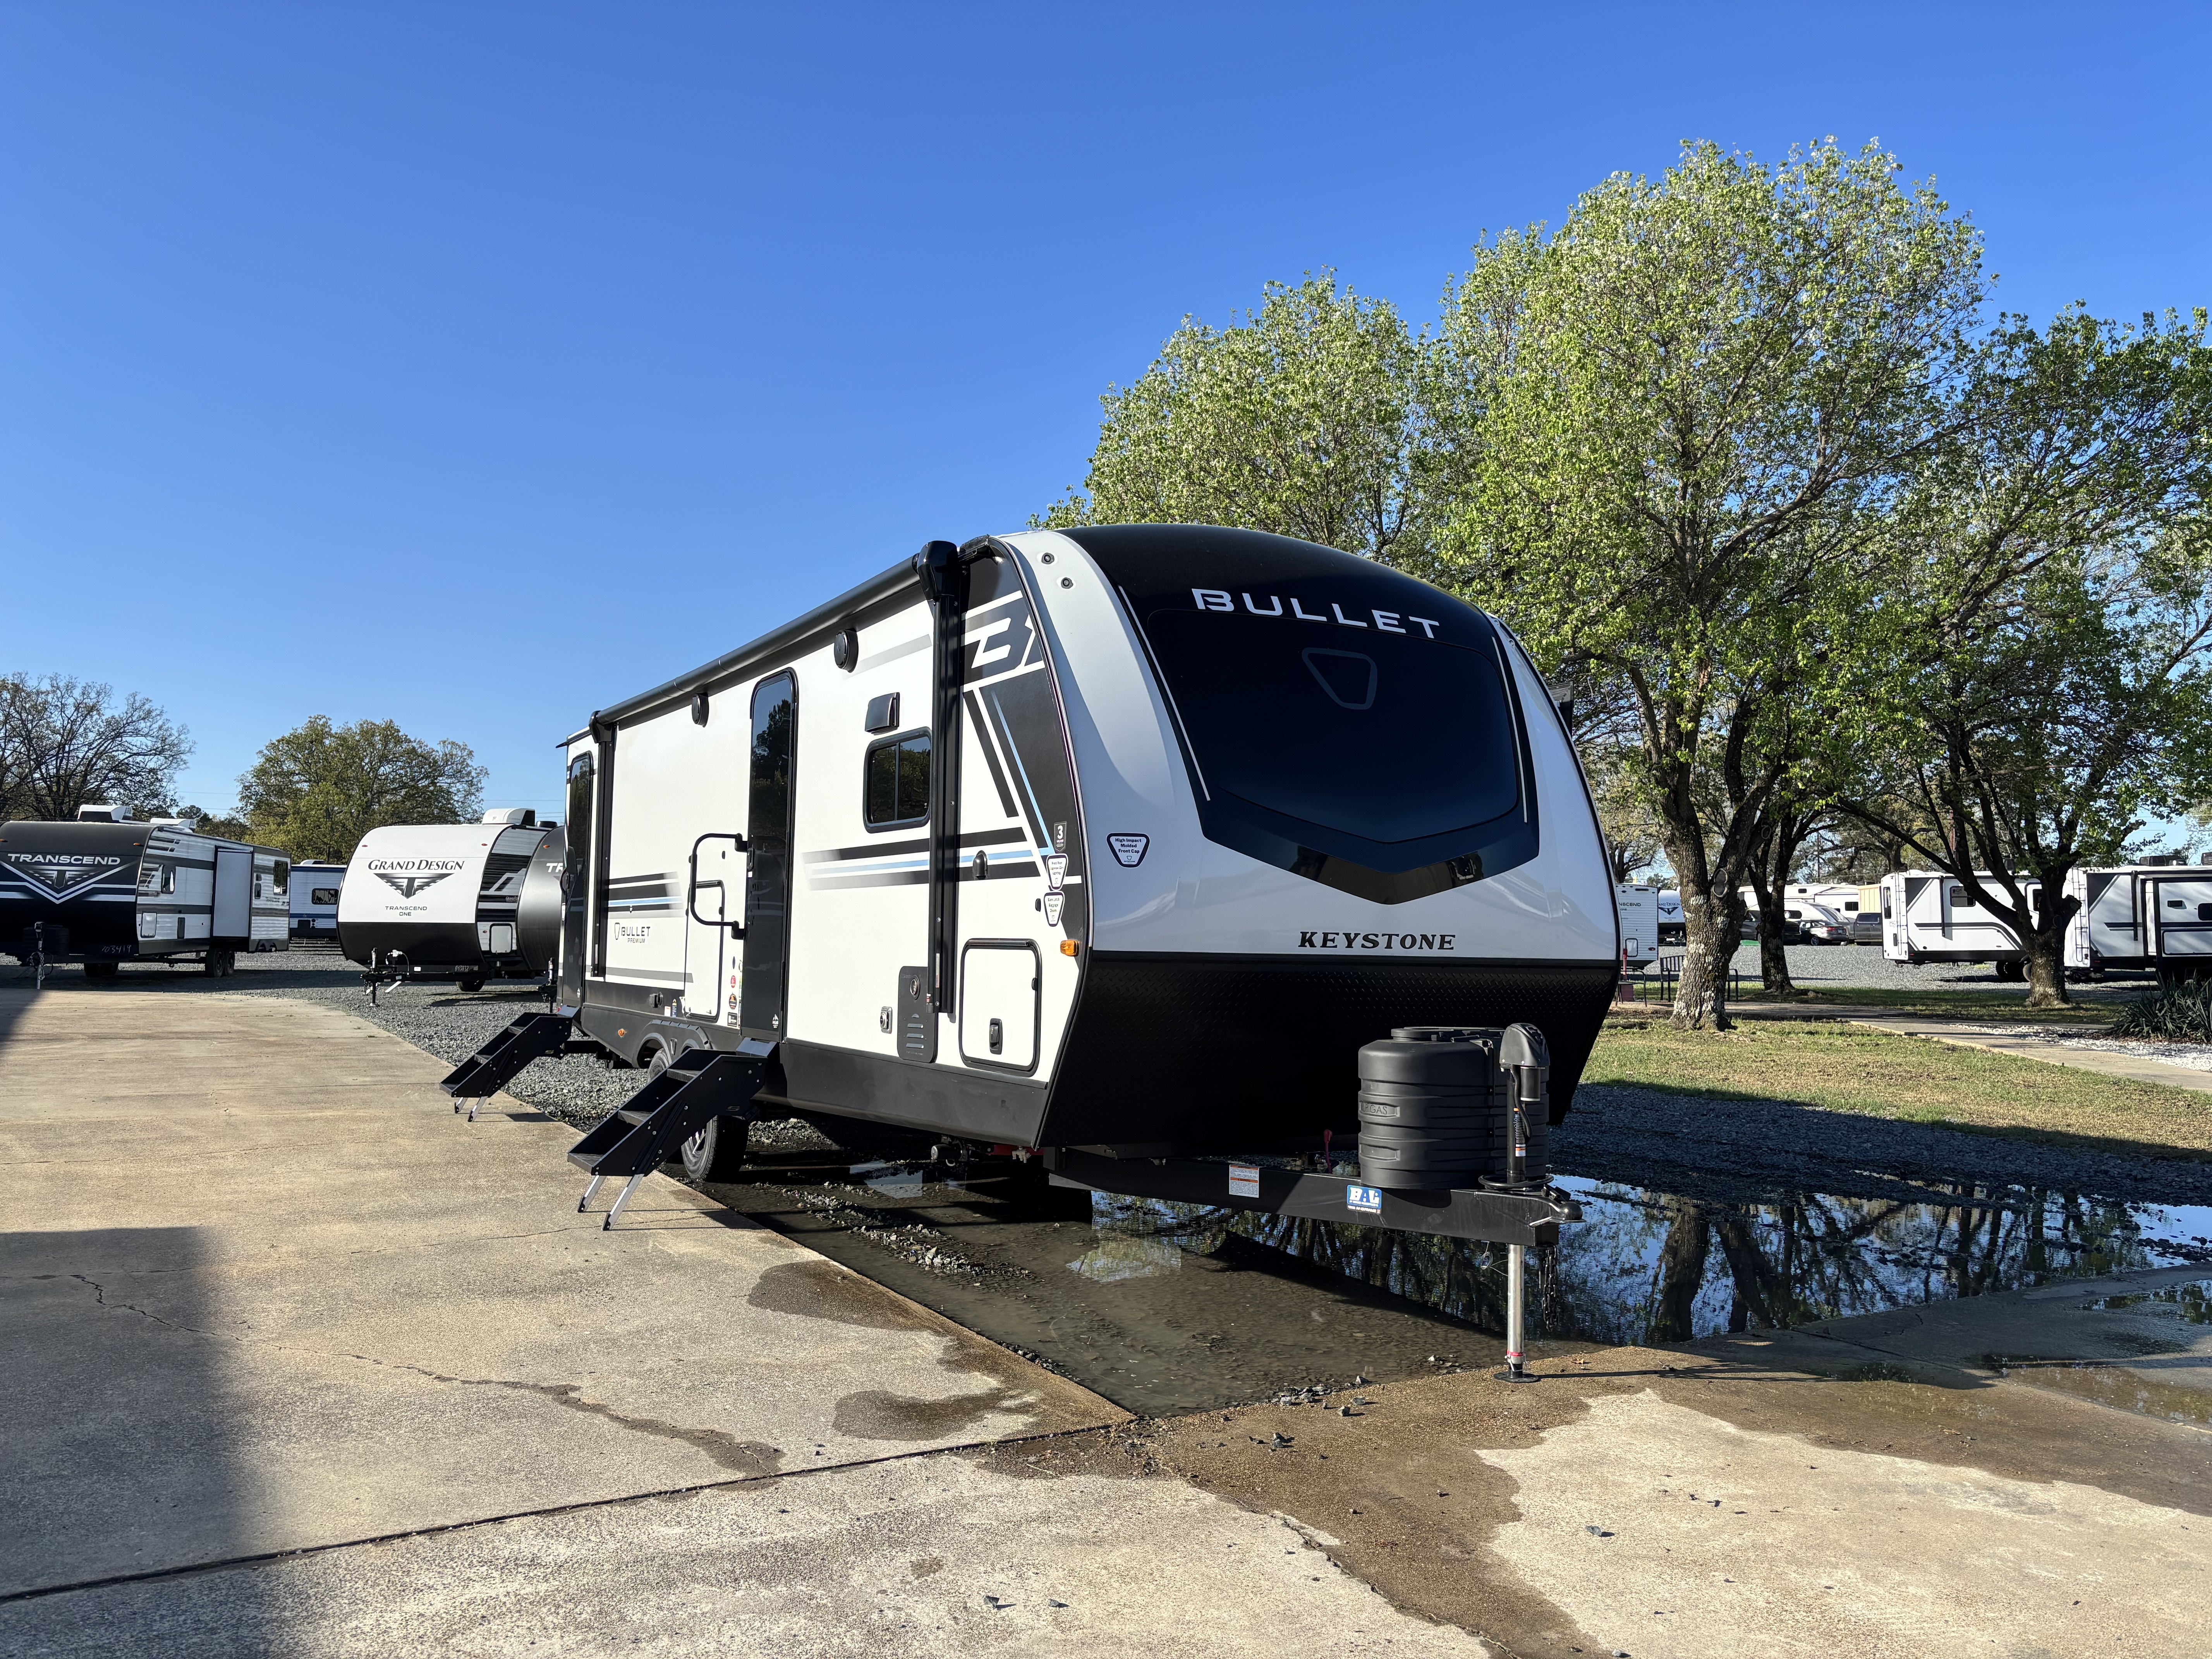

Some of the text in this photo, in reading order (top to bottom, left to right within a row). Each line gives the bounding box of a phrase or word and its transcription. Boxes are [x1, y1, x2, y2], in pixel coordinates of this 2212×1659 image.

[1192, 588, 1440, 639] BULLET
[1057, 825, 1063, 839] 3
[8, 854, 120, 865] TRANSCEND
[368, 859, 465, 870] GRAND DESIGN
[622, 926, 651, 937] BULLET
[1298, 931, 1456, 950] KEYSTONE
[1370, 1104, 1388, 1115] GAS
